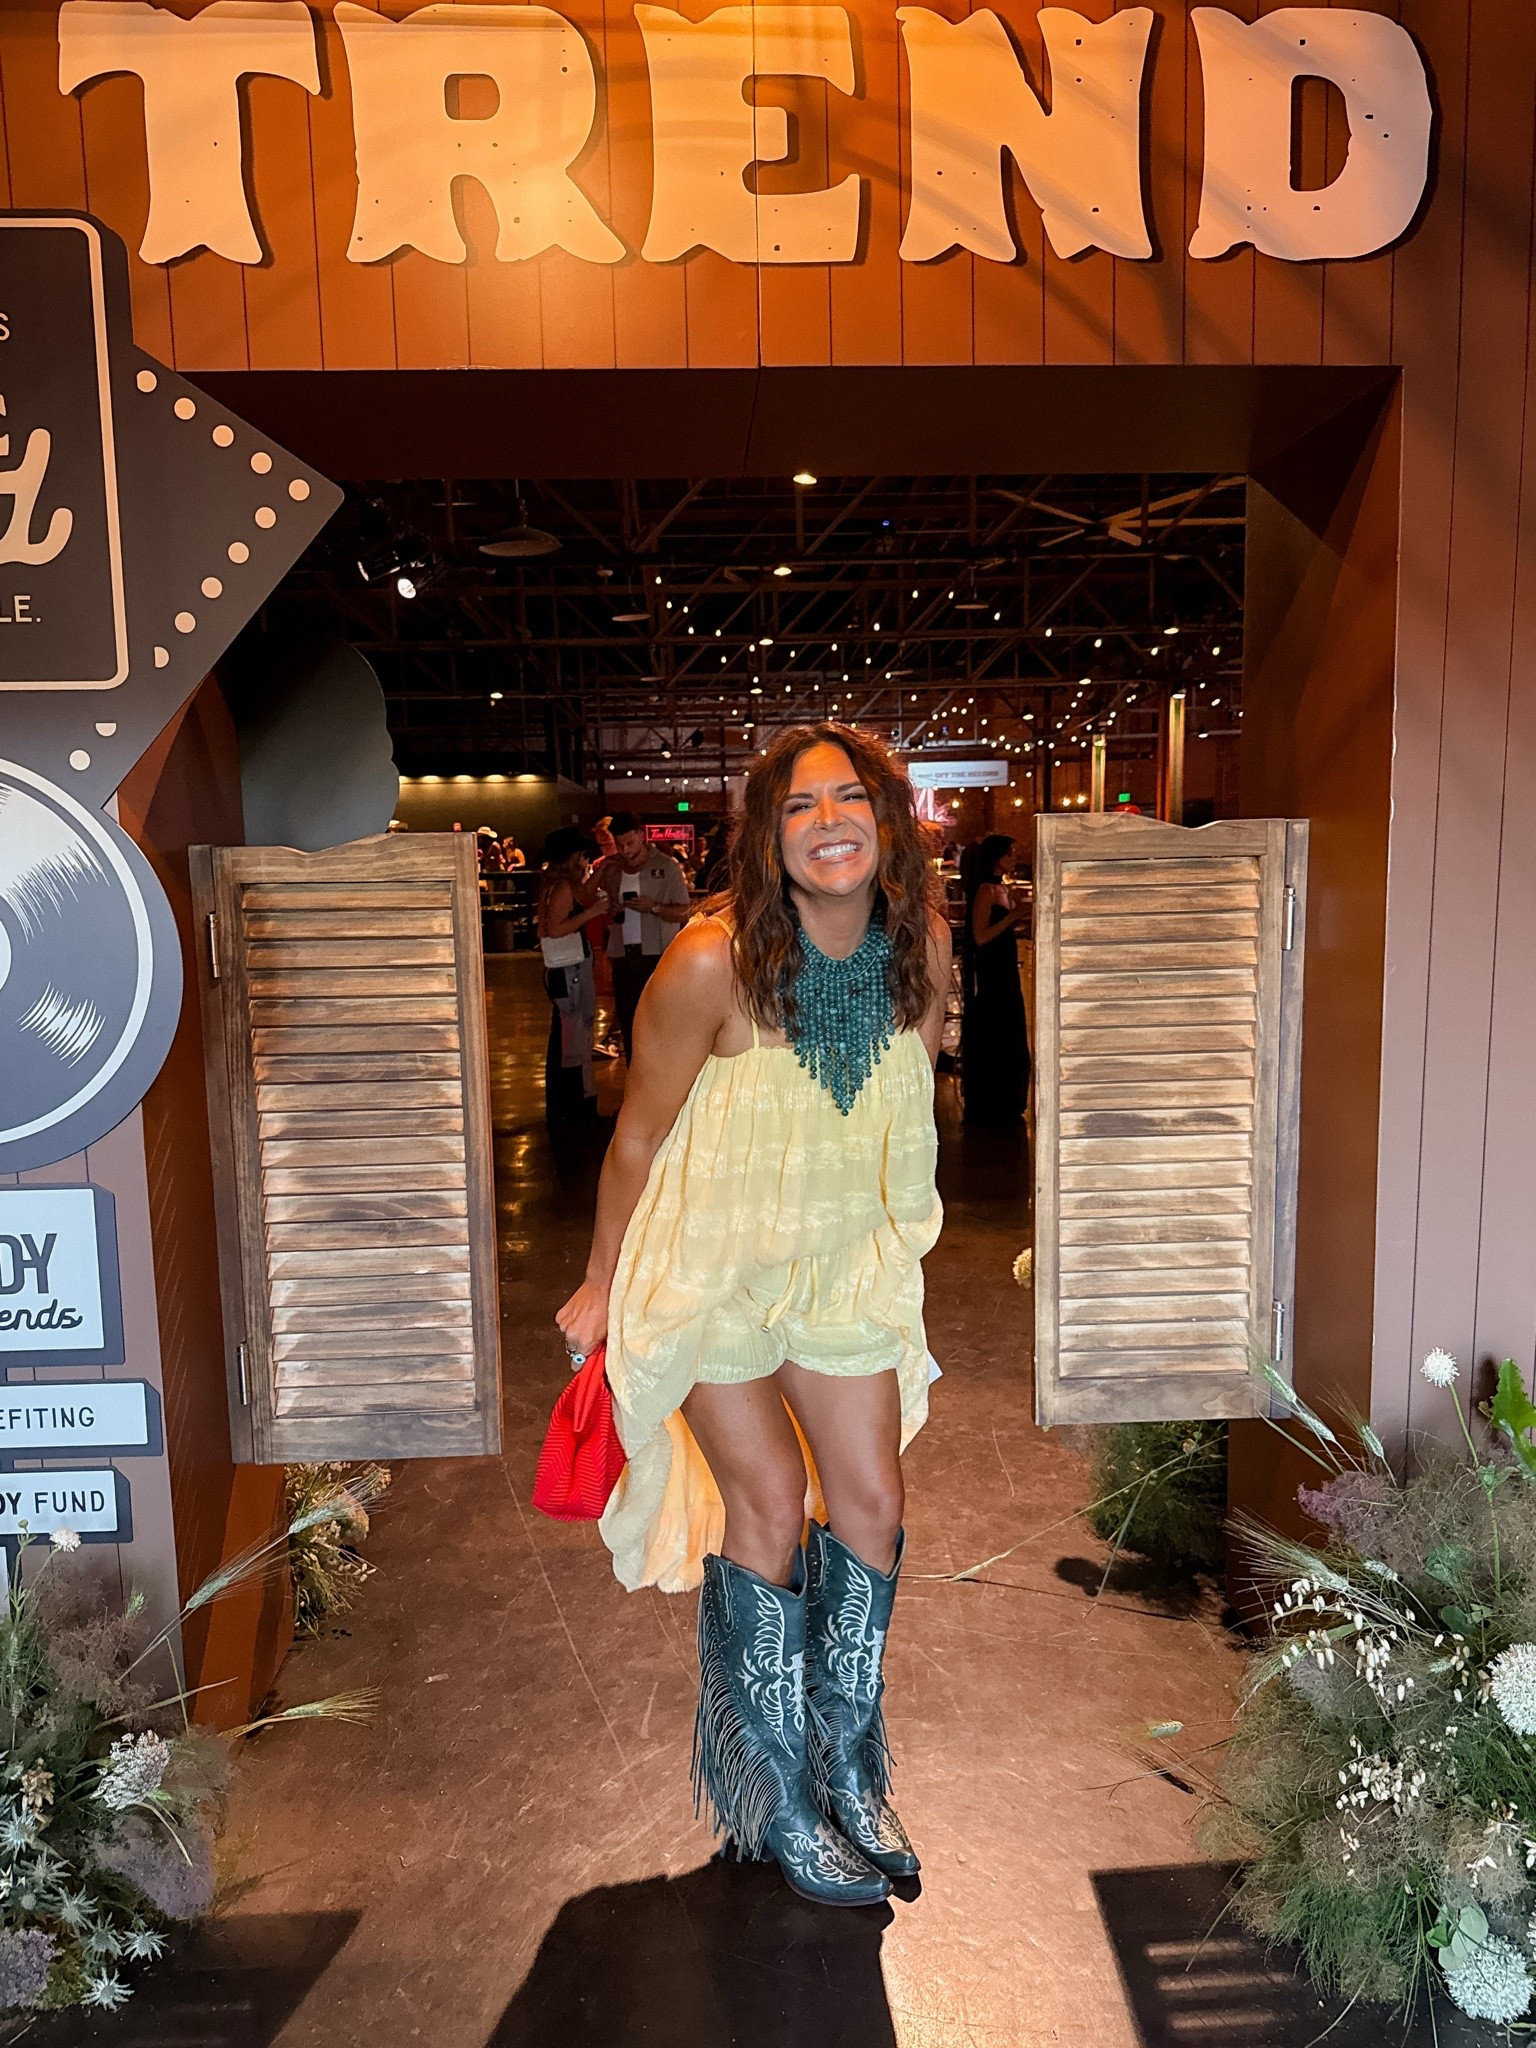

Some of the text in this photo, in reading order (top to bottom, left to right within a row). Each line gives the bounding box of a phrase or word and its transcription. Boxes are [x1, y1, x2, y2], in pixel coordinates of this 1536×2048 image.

[58, 1, 1433, 264] TREND
[0, 1233, 58, 1295] DY
[0, 1298, 83, 1331] ends
[34, 1490, 105, 1514] FUND
